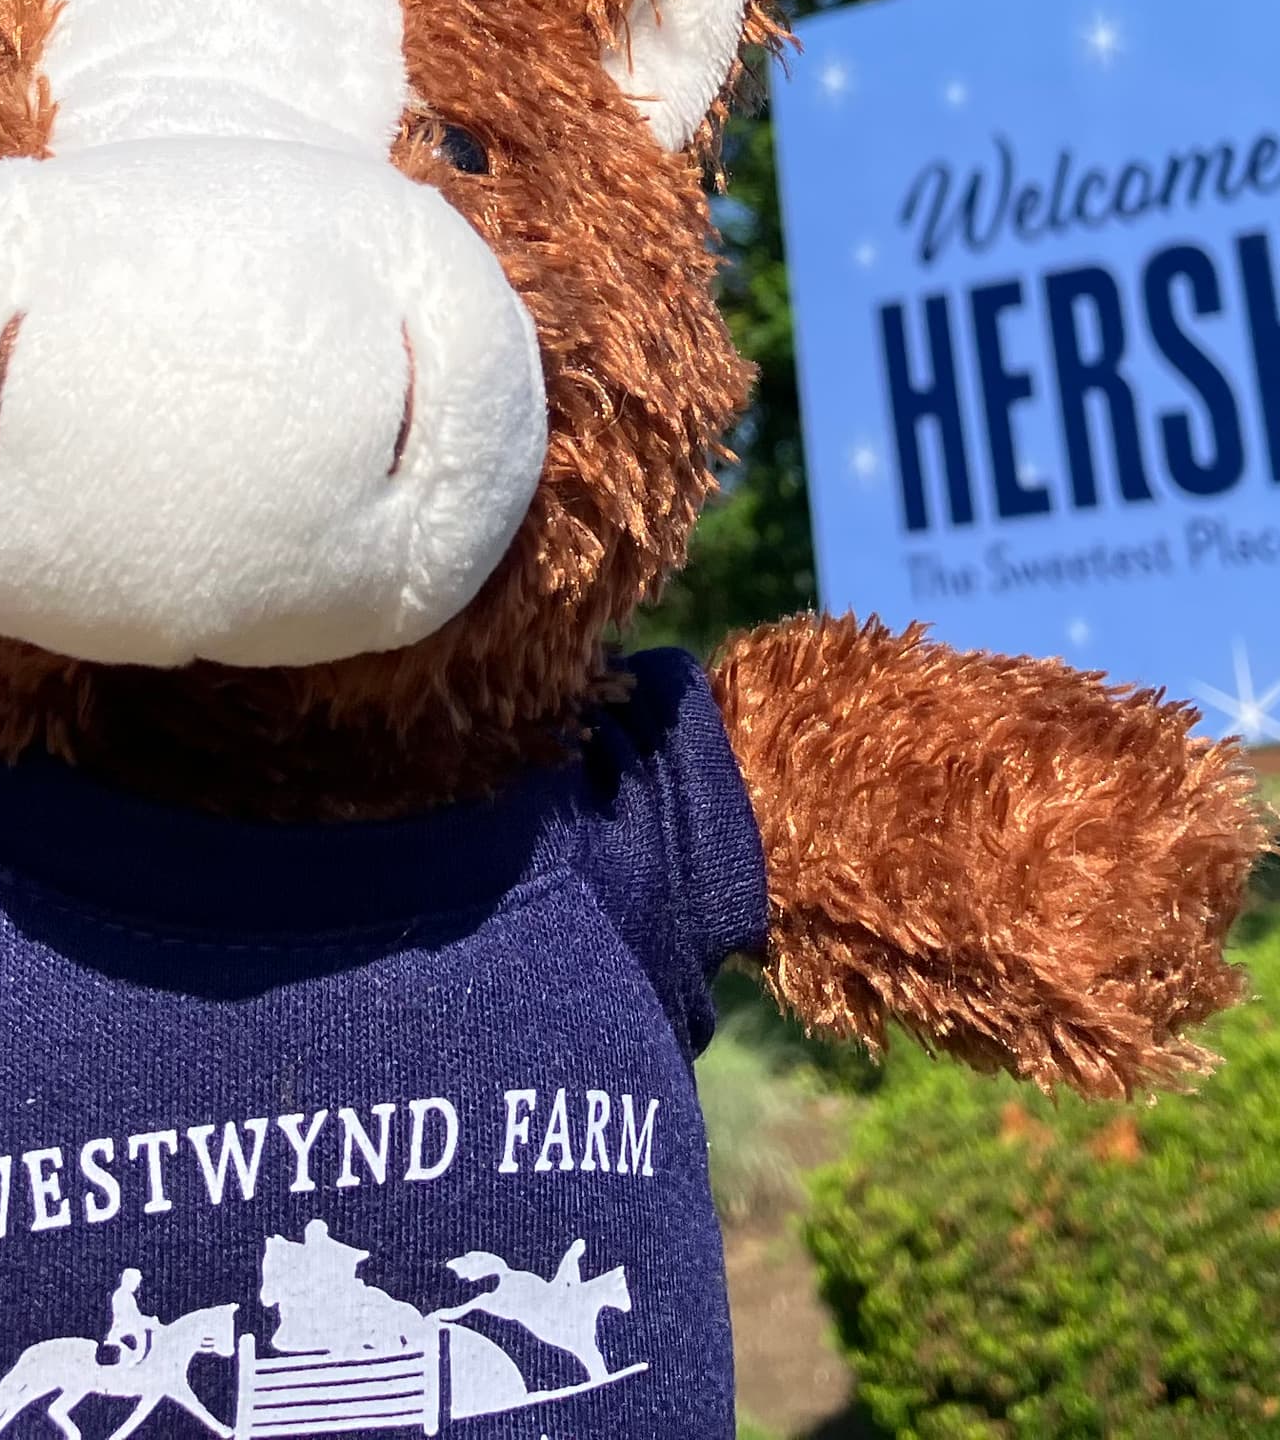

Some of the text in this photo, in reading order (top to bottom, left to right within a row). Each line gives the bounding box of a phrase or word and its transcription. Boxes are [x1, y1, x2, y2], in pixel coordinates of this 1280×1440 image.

[905, 552, 976, 602] The
[984, 537, 1174, 593] Sweetest
[498, 1088, 660, 1178] FARM
